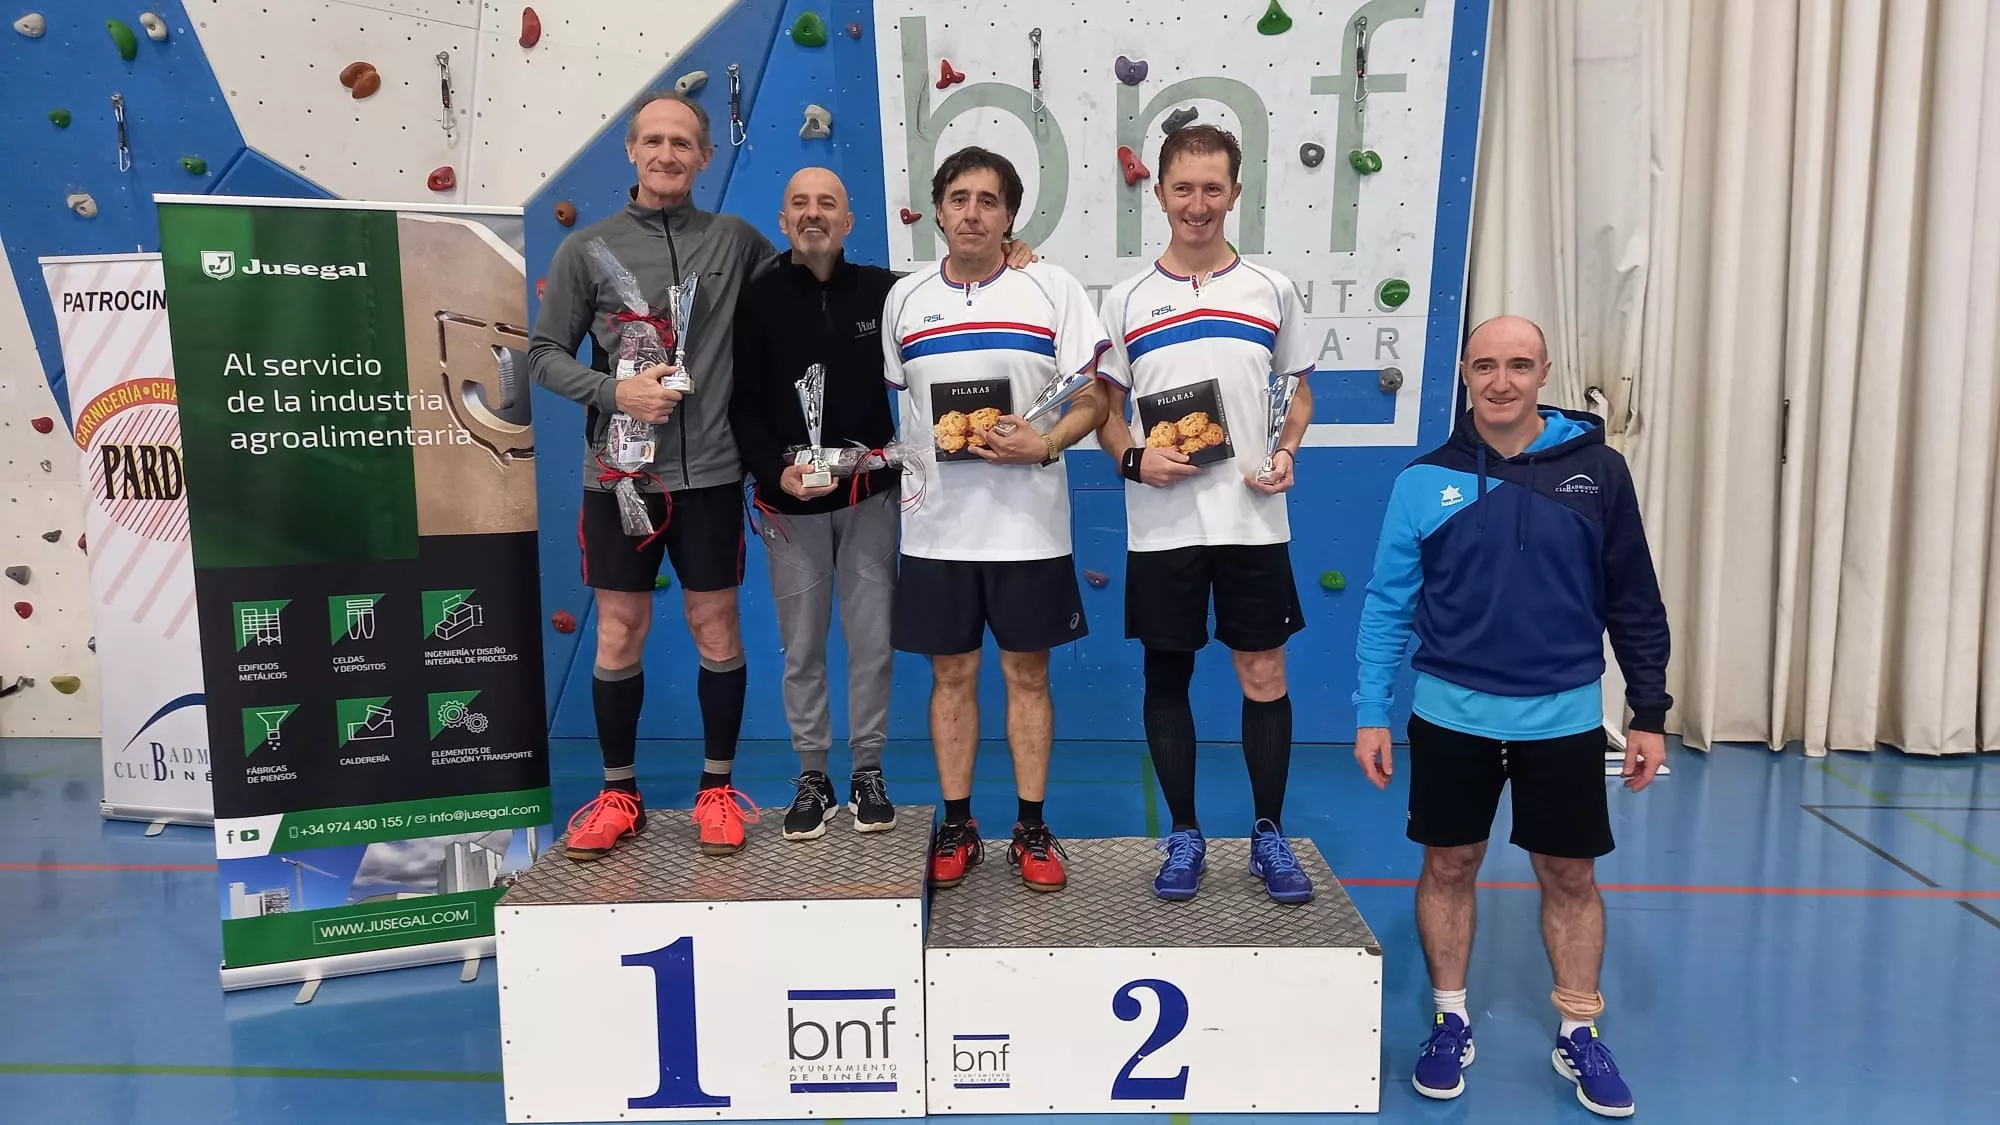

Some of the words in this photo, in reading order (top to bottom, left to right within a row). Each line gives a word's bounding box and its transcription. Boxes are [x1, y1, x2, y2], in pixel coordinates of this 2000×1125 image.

[241, 259, 368, 280] Jusegal
[63, 290, 167, 312] PATROCIN
[1151, 304, 1177, 318] RSL
[923, 313, 944, 324] RSL
[223, 353, 257, 376] Al
[263, 353, 382, 376] servicio
[951, 386, 990, 396] PILARAS
[227, 390, 265, 413] de
[274, 390, 301, 412] la
[311, 389, 443, 411] industria
[1157, 391, 1194, 407] PILARAS
[76, 382, 143, 445] CARNICERÍA
[230, 424, 472, 455] agroalimentaria
[424, 648, 469, 658] INGENIERÍA
[469, 648, 477, 656] Y
[477, 646, 506, 655] DISEÑO
[238, 662, 279, 672] EDIFICIOS
[333, 656, 365, 664] CELDAS
[425, 657, 464, 666] INTEGRAL
[465, 656, 476, 664] DE
[477, 654, 518, 663] PROCESOS
[333, 665, 340, 673] Y
[340, 663, 387, 673] DEPOSITOS
[239, 671, 288, 681] METÁLICOS
[431, 748, 479, 758] ELEMENTOS
[480, 747, 491, 755] DE
[432, 755, 474, 765] ELEVACIÓN
[482, 751, 533, 761] TRANSPORTE
[340, 754, 390, 766] CALDERERÍA
[246, 765, 287, 775] FÁBRICAS
[247, 775, 259, 784] DE
[260, 772, 297, 783] PIENSOS
[300, 824, 324, 836] +34
[327, 822, 351, 833] 974
[353, 819, 377, 831] 430
[381, 816, 403, 828] 155
[430, 804, 540, 823] info@jusegal.com
[320, 909, 469, 938] WWW.JUSEGAL.COM
[621, 936, 731, 1109] 1
[787, 1005, 896, 1060] bnf
[1110, 979, 1189, 1100] 2
[953, 1043, 1010, 1072] bnf
[789, 1063, 897, 1072] AYUNTAMIENTO
